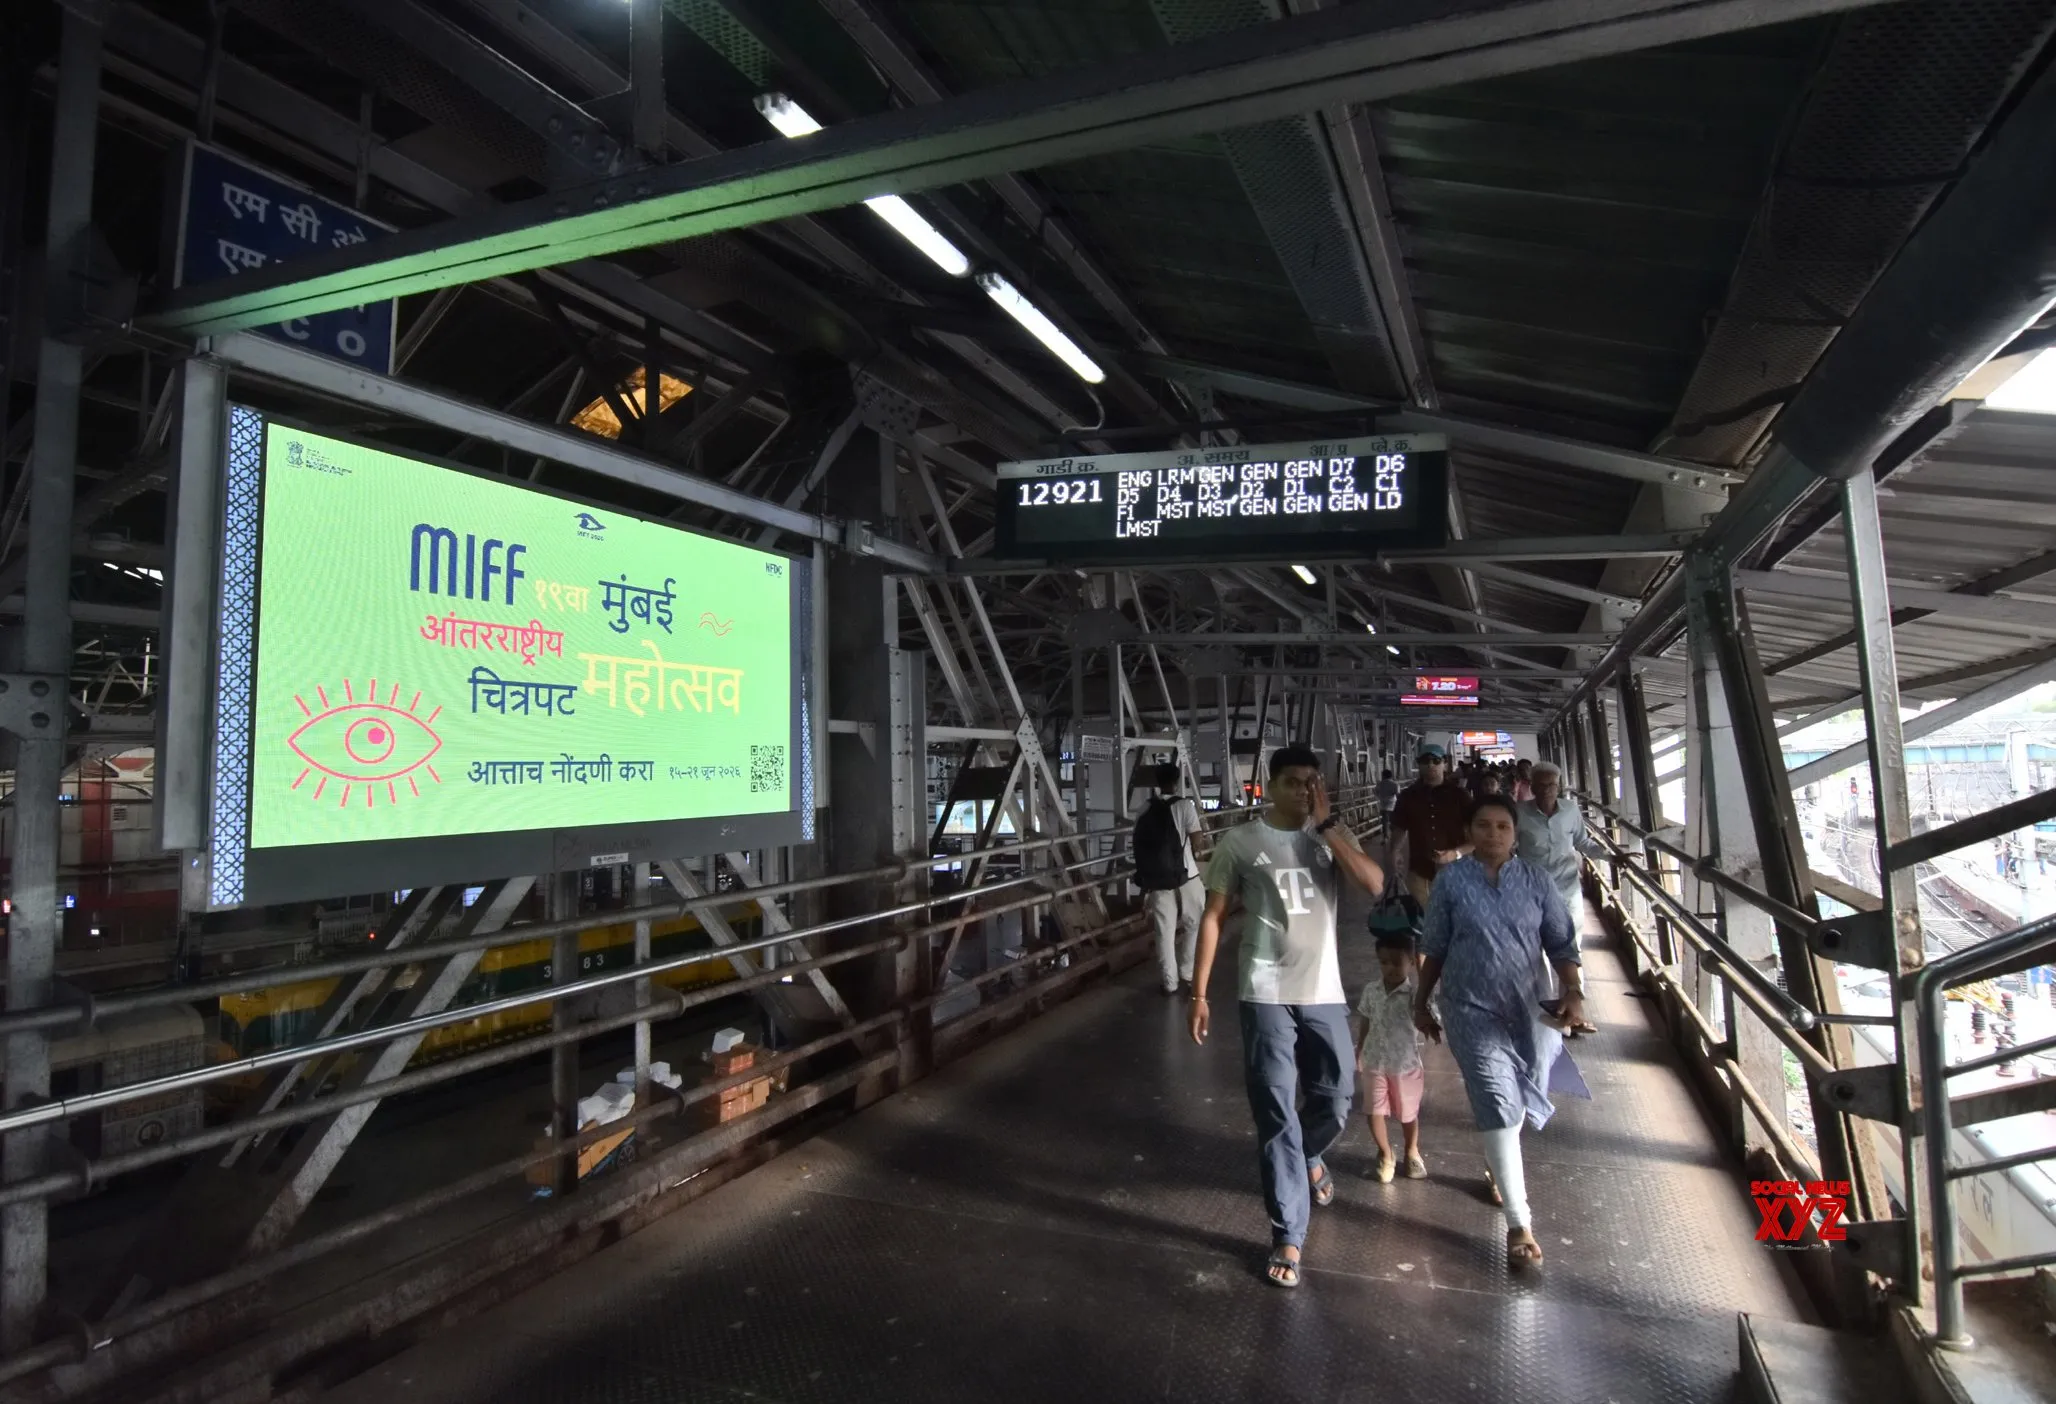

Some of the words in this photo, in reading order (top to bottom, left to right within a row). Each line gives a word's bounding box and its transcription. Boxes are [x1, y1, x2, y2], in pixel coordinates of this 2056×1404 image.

[221, 182, 271, 223] एम
[279, 203, 322, 244] सी
[1036, 459, 1073, 475] गाडी
[1117, 471, 1152, 489] ENG
[1157, 468, 1195, 486] LRM
[1198, 465, 1235, 484] GEN
[1240, 462, 1278, 480] GEN
[1284, 459, 1323, 478] GEN
[1329, 457, 1355, 476] D7
[1375, 454, 1405, 473] D6
[1204, 450, 1250, 463] समय
[1018, 480, 1103, 506] 12921
[1116, 505, 1135, 521] F1
[1156, 502, 1194, 519] MST
[1197, 500, 1234, 518] MST
[1239, 498, 1277, 516] GEN
[1283, 496, 1322, 514] GEN
[1328, 493, 1369, 512] GEN
[1375, 491, 1402, 510] LD
[1117, 488, 1139, 505] D5
[1157, 486, 1181, 503] D4
[1198, 484, 1221, 501] D3
[1240, 481, 1265, 498] D2
[1284, 479, 1305, 496] D1
[1328, 476, 1355, 494] C2
[1375, 474, 1399, 492] C1
[1116, 520, 1162, 538] LMST
[410, 523, 527, 606] MIFF
[535, 579, 591, 613] १९वा
[598, 573, 677, 633] मुंबई
[419, 611, 564, 667] आंतरराष्ट्रीय
[467, 666, 578, 717] चित्रपट
[577, 639, 745, 718] महोत्सव
[467, 760, 544, 785] आत्ताच
[550, 753, 613, 785] नोंदणी
[618, 760, 655, 783] करा
